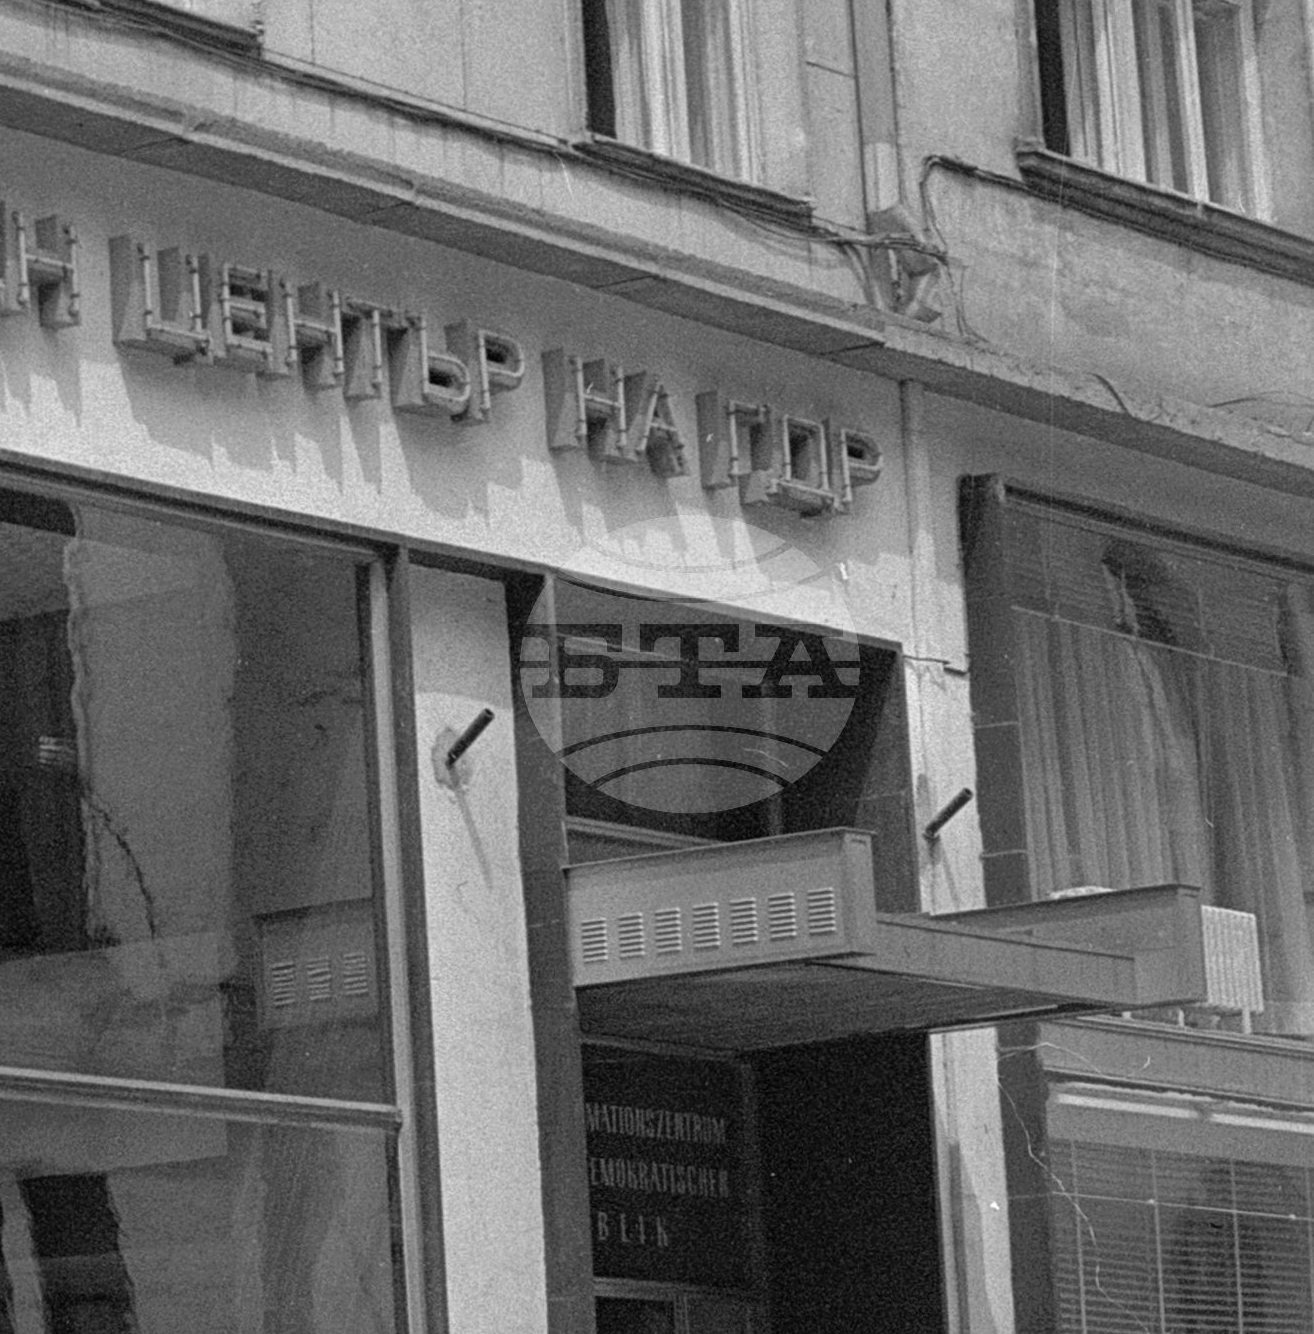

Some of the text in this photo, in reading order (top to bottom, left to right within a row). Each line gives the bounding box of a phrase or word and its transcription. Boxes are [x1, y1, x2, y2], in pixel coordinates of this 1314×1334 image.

[109, 233, 525, 423] ЦЕНТЪР
[541, 345, 689, 477] НА
[696, 389, 883, 516] ГДР
